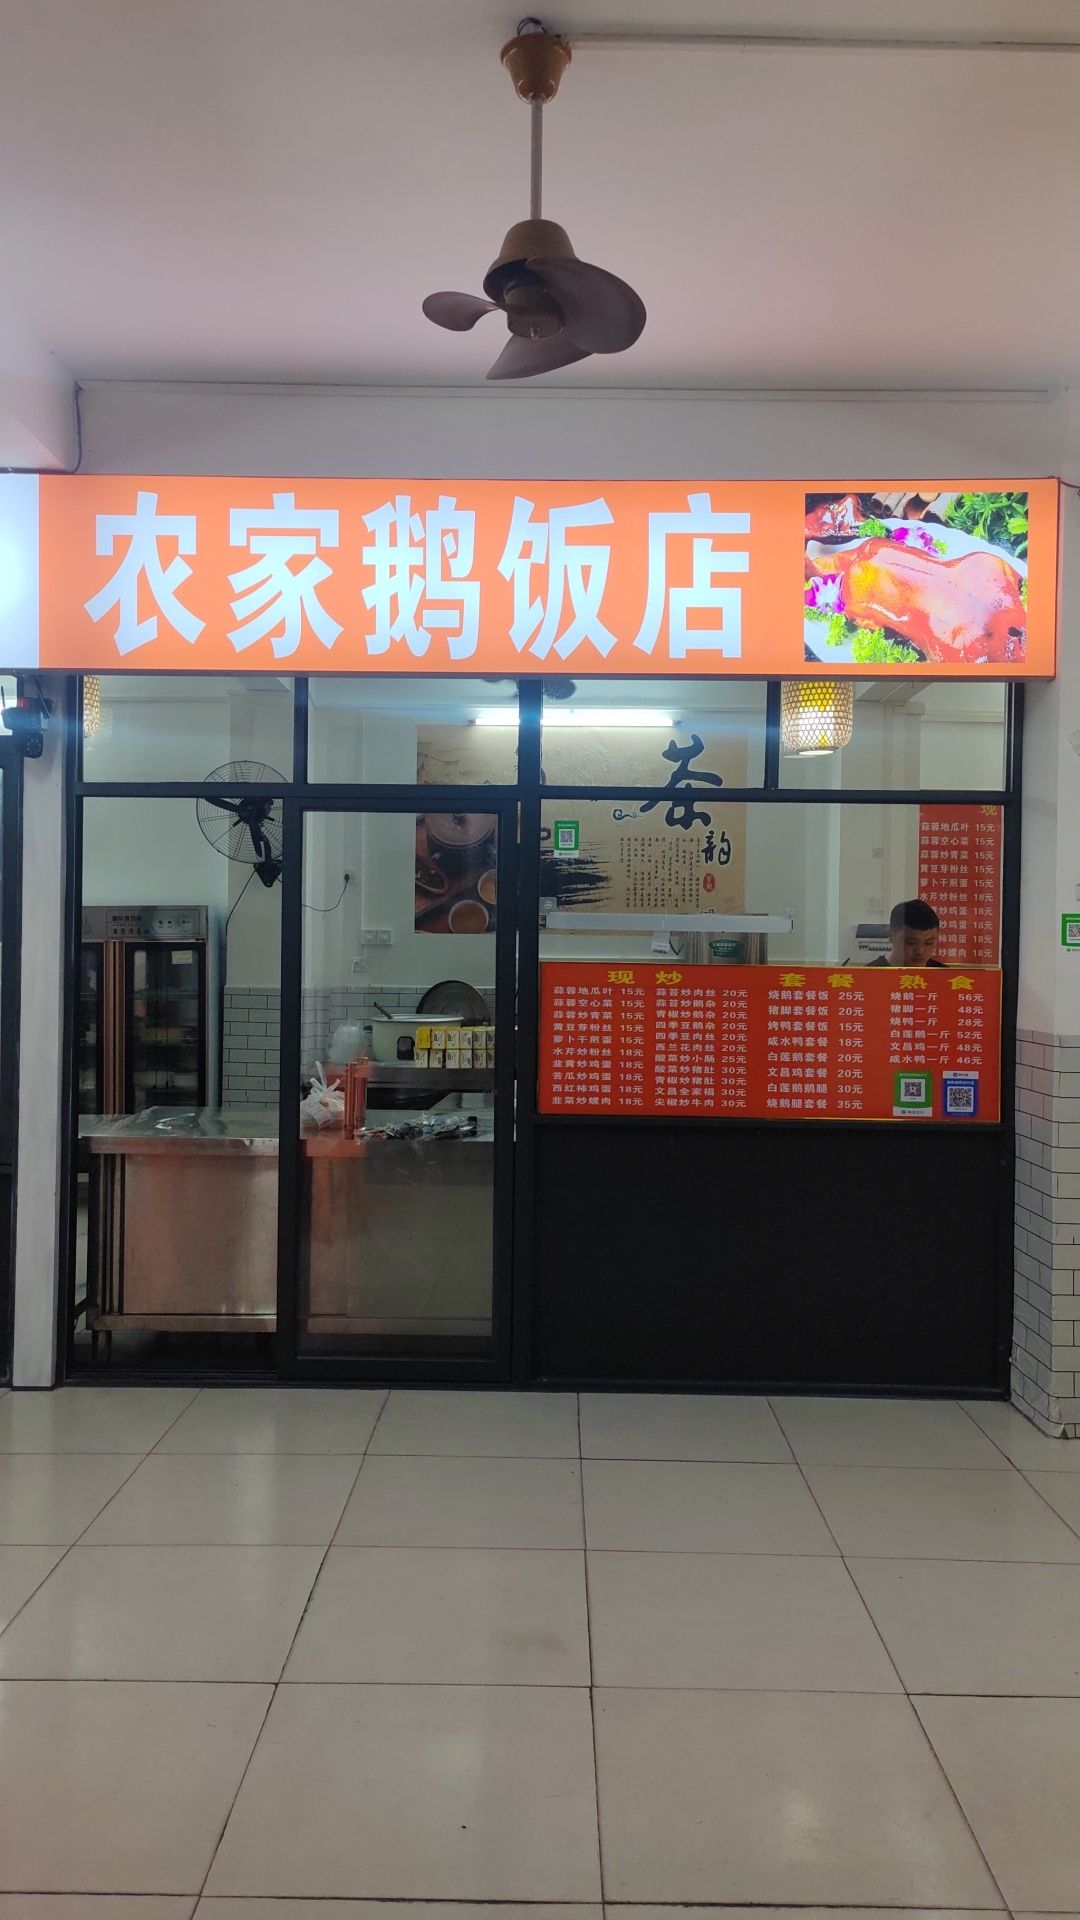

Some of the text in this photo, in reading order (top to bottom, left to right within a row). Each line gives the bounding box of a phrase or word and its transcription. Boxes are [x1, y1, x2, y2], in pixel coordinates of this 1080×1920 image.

[83, 490, 751, 661] 农家鹅饭店
[976, 823, 996, 833] 15元
[975, 837, 995, 847] 15元
[701, 830, 732, 866] 韵
[975, 850, 995, 861] 15元
[974, 864, 995, 875] 15元
[974, 878, 995, 888] 15元
[974, 892, 994, 903] 18元
[973, 906, 994, 917] 18元
[973, 920, 994, 930] 18元
[973, 934, 994, 944] 18元
[972, 948, 993, 958] 18元
[607, 969, 683, 985] 现炒
[779, 972, 855, 988] 套餐
[899, 974, 975, 990] 熟食
[621, 987, 646, 996] 15元
[723, 989, 748, 998] 20元
[839, 991, 865, 1001] 25元
[959, 993, 984, 1002] 56元
[620, 999, 645, 1009] 15元
[723, 1000, 748, 1009] 20元
[839, 1006, 864, 1017] 20元
[959, 1005, 984, 1015] 48元
[620, 1012, 645, 1020] 15元
[723, 1011, 748, 1020] 20元
[723, 1022, 748, 1031] 20元
[839, 1022, 864, 1032] 15元
[959, 1018, 984, 1027] 28元
[620, 1024, 645, 1033] 15元
[620, 1036, 644, 1045] 15元
[722, 1033, 748, 1042] 20元
[957, 1031, 983, 1040] 52元
[838, 1037, 864, 1048] 18元
[620, 1048, 644, 1057] 18元
[722, 1044, 747, 1053] 20元
[957, 1043, 983, 1053] 48元
[722, 1055, 747, 1064] 25元
[838, 1053, 864, 1063] 20元
[957, 1056, 983, 1065] 46元
[619, 1060, 644, 1070] 18元
[722, 1066, 747, 1075] 30元
[838, 1068, 863, 1079] 20元
[619, 1073, 644, 1082] 18元
[722, 1077, 747, 1086] 30元
[619, 1085, 644, 1094] 18元
[722, 1088, 747, 1097] 30元
[838, 1084, 863, 1094] 30元
[620, 1097, 644, 1106] 18元
[722, 1099, 747, 1108] 30元
[838, 1099, 863, 1110] 35元
